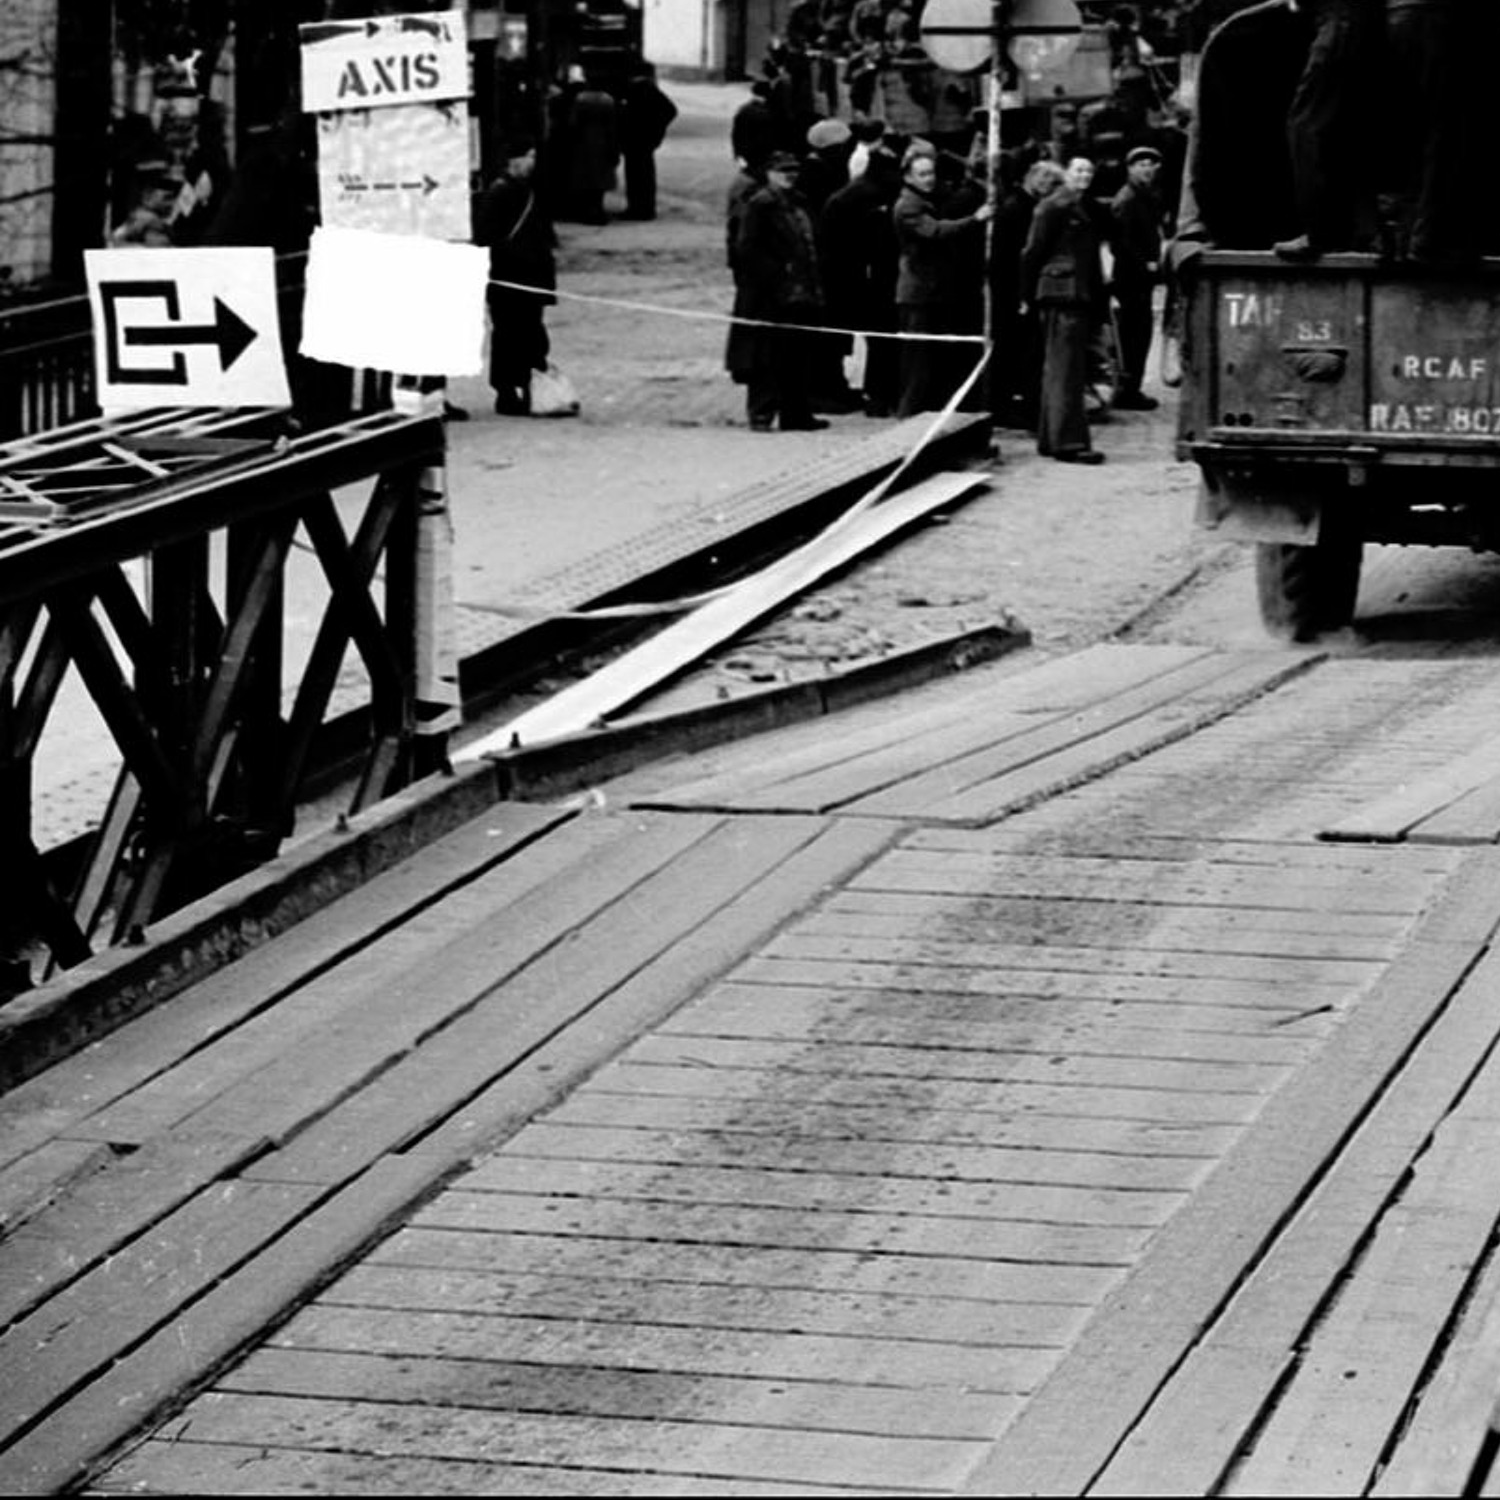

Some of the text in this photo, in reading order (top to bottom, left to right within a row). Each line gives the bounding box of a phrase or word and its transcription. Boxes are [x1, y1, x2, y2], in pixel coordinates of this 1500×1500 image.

[338, 54, 440, 98] AXIS
[1404, 355, 1487, 379] RCAF
[1371, 404, 1435, 431] RAF
